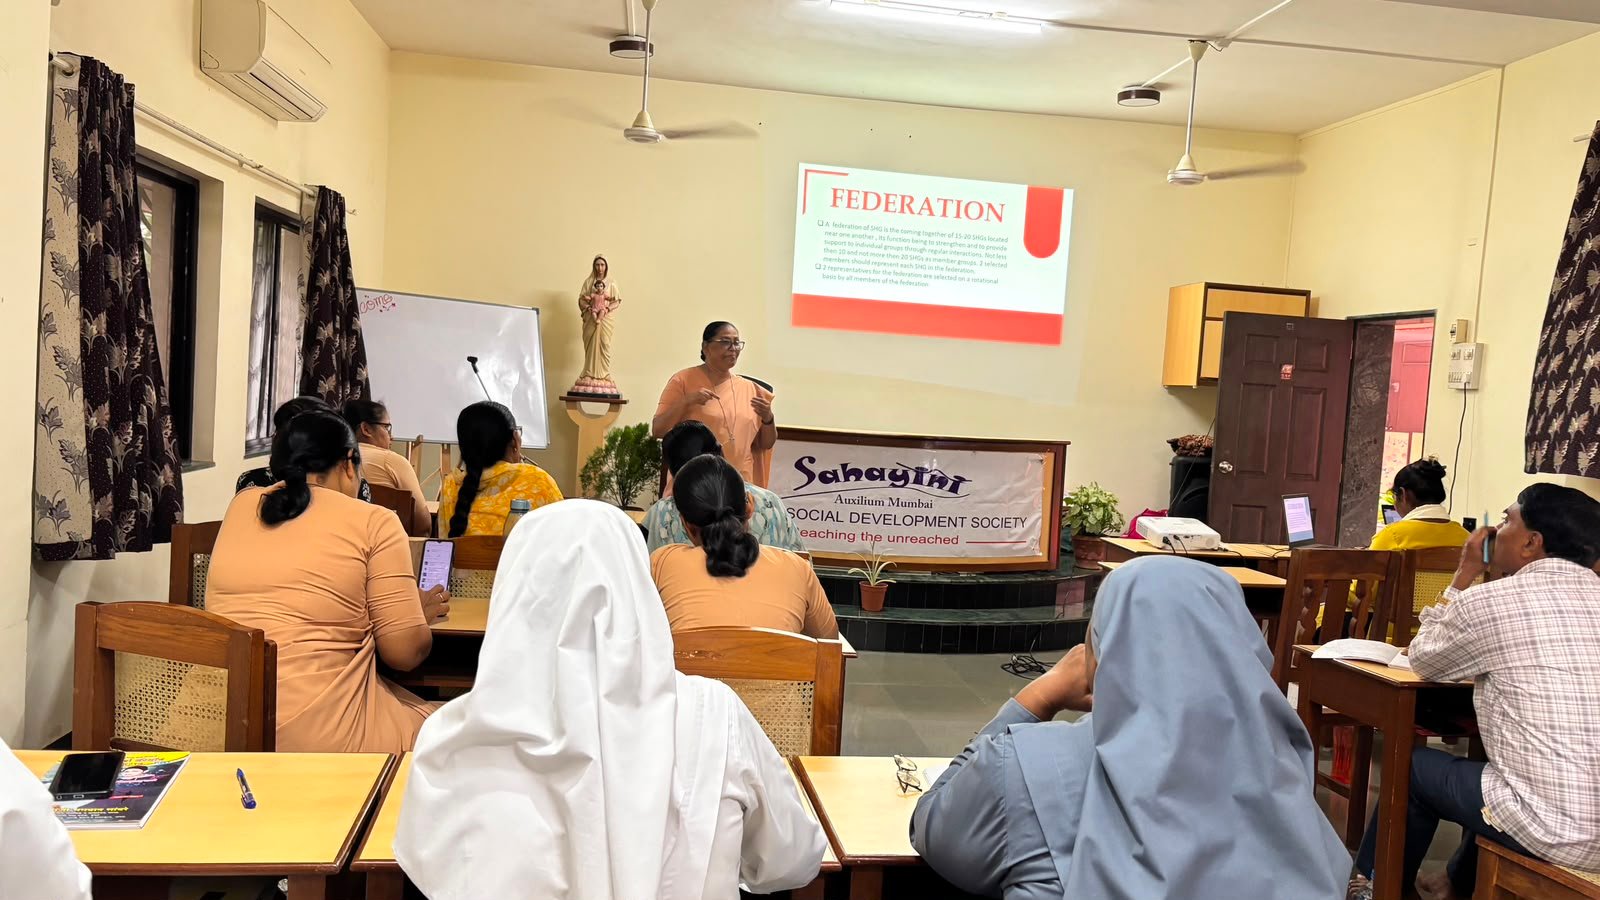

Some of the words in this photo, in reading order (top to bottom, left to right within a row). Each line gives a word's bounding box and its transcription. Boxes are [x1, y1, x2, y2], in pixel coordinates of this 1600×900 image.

[830, 187, 1006, 223] FEDERATION
[833, 222, 863, 230] federation
[900, 228, 921, 236] coming
[922, 230, 946, 238] together
[988, 235, 1008, 243] located
[887, 236, 910, 244] function
[912, 238, 927, 246] being
[936, 240, 966, 248] strengthen
[986, 244, 1008, 252] provide
[904, 246, 926, 254] through
[872, 260, 898, 268] represent
[828, 265, 872, 274] representatives
[892, 270, 922, 278] federation
[934, 274, 957, 282] selected
[854, 276, 880, 284] members
[834, 494, 885, 507] Auxilium
[888, 496, 934, 509] Mumbai
[786, 507, 844, 523] SOCIAL
[849, 512, 967, 528] DEVELOPMENT
[970, 516, 1028, 528] SOCIETY
[800, 528, 856, 543] eaching
[861, 532, 882, 542] the
[887, 534, 960, 545] unreached
